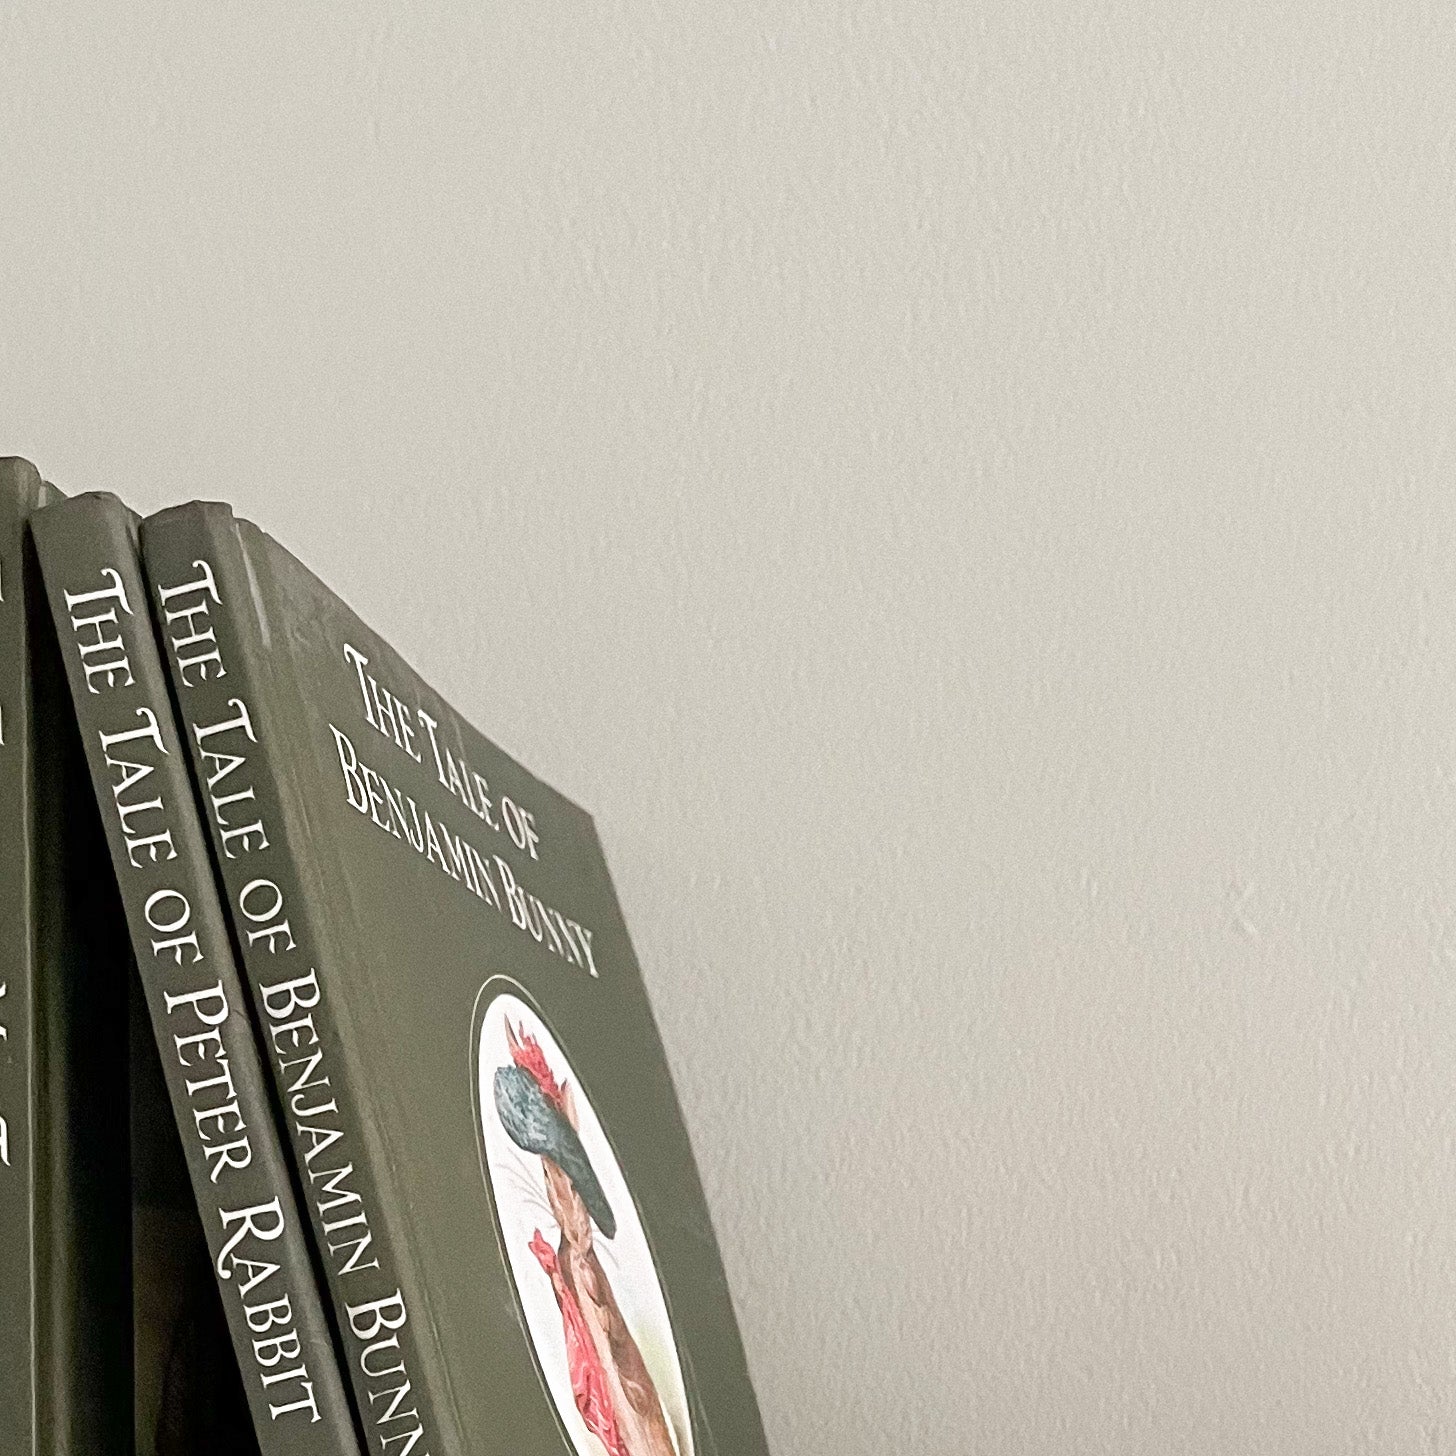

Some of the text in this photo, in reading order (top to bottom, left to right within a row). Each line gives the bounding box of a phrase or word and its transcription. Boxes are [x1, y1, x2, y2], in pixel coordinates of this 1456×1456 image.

[158, 559, 227, 687] THE
[192, 698, 270, 860] TALE
[328, 722, 599, 979] BENJAMIN BUNNY
[343, 642, 540, 861] THE TALE OF
[63, 567, 322, 1424] THE TALE OF PETER RABBIT
[239, 878, 297, 954] OF
[259, 967, 381, 1277] BENJAMIN
